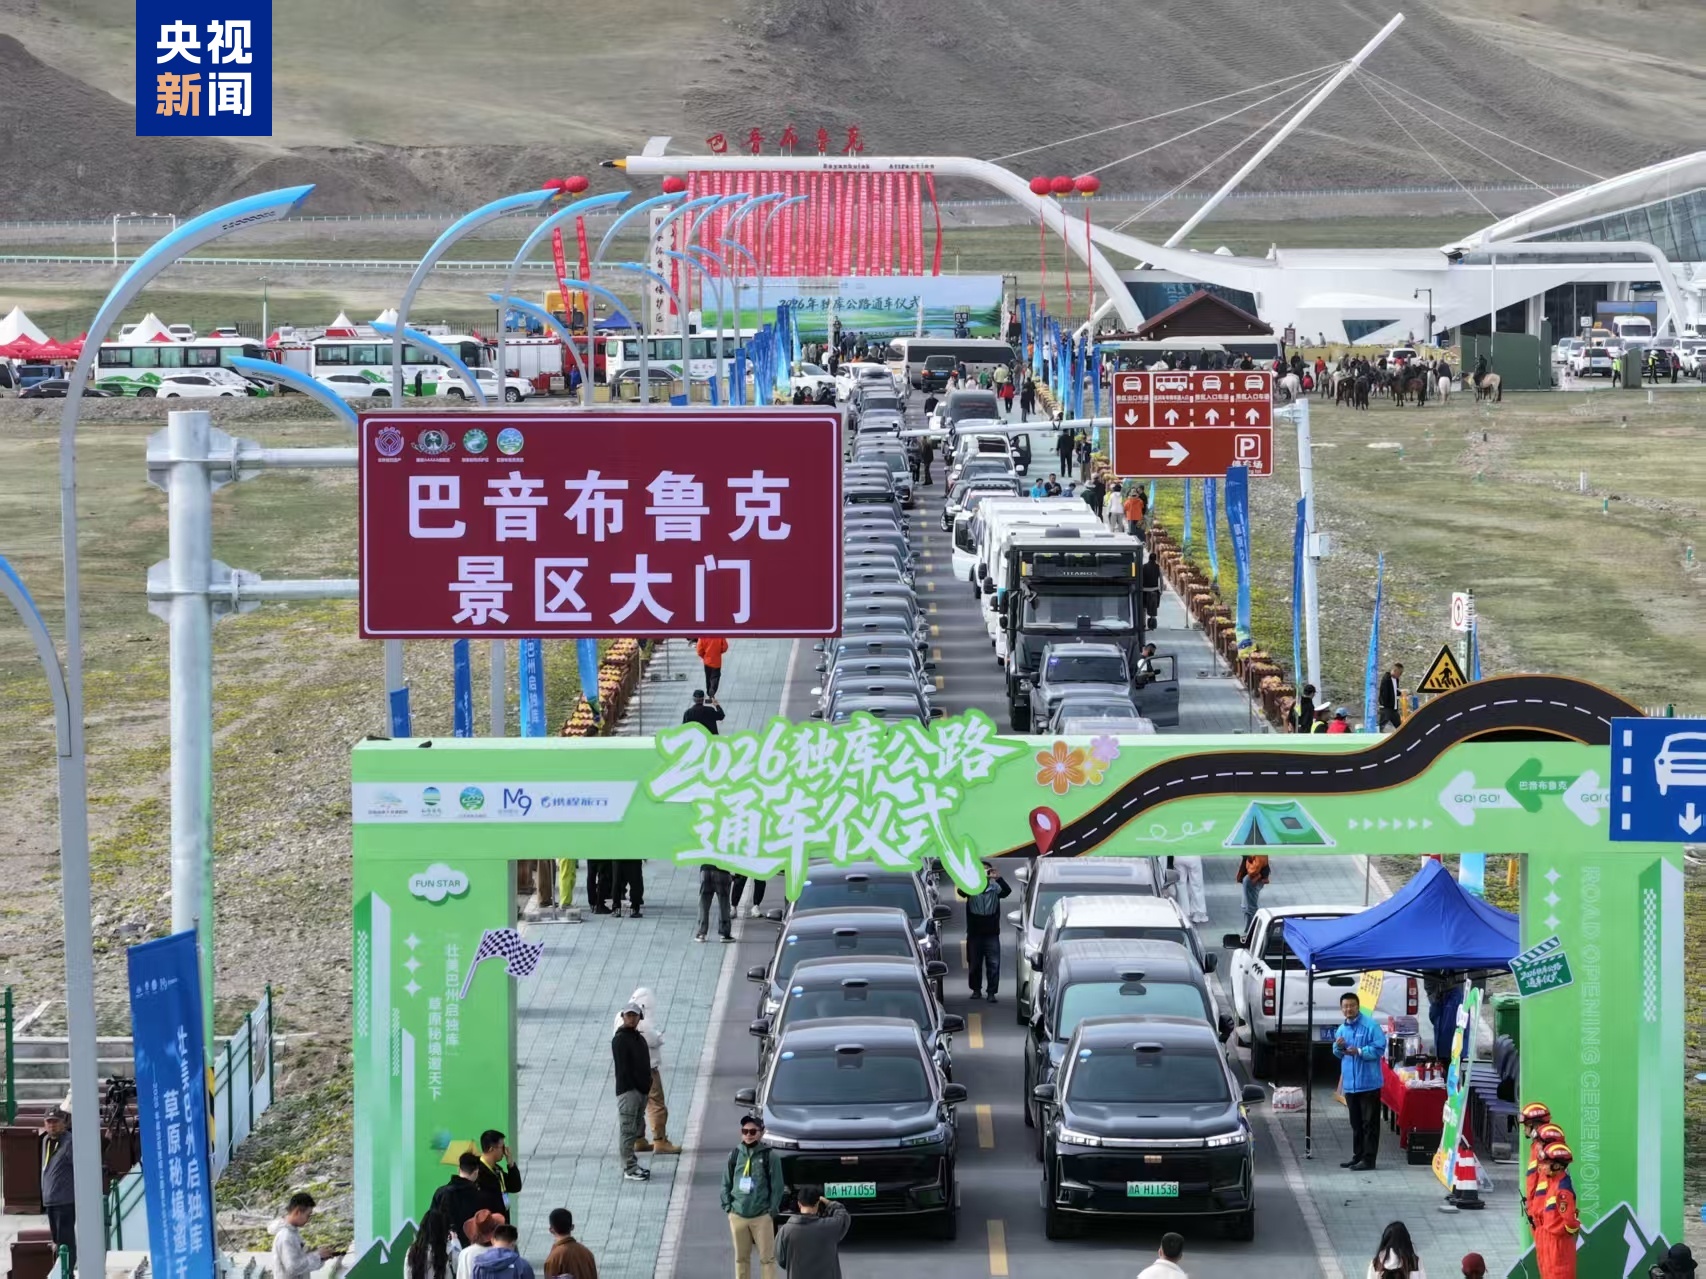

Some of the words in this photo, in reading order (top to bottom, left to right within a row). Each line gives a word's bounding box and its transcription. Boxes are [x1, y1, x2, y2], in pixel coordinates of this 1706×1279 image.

[705, 123, 864, 154] 巴音布鲁克
[1240, 437, 1256, 457] P
[408, 469, 791, 542] 巴音布鲁克
[448, 553, 752, 624] 景区大门
[649, 716, 1020, 801] 2026独库公路
[1518, 781, 1568, 791] 巴音布鲁克
[503, 788, 532, 817] M9
[1454, 794, 1476, 803] GO!
[1479, 794, 1501, 803] GO!
[676, 783, 985, 896] 通车仪式
[415, 880, 435, 888] FUN
[436, 880, 461, 888] STAR
[1582, 866, 1600, 939] ROAD
[1582, 946, 1600, 1064] OPENING
[1582, 1070, 1600, 1218] CEREMONY
